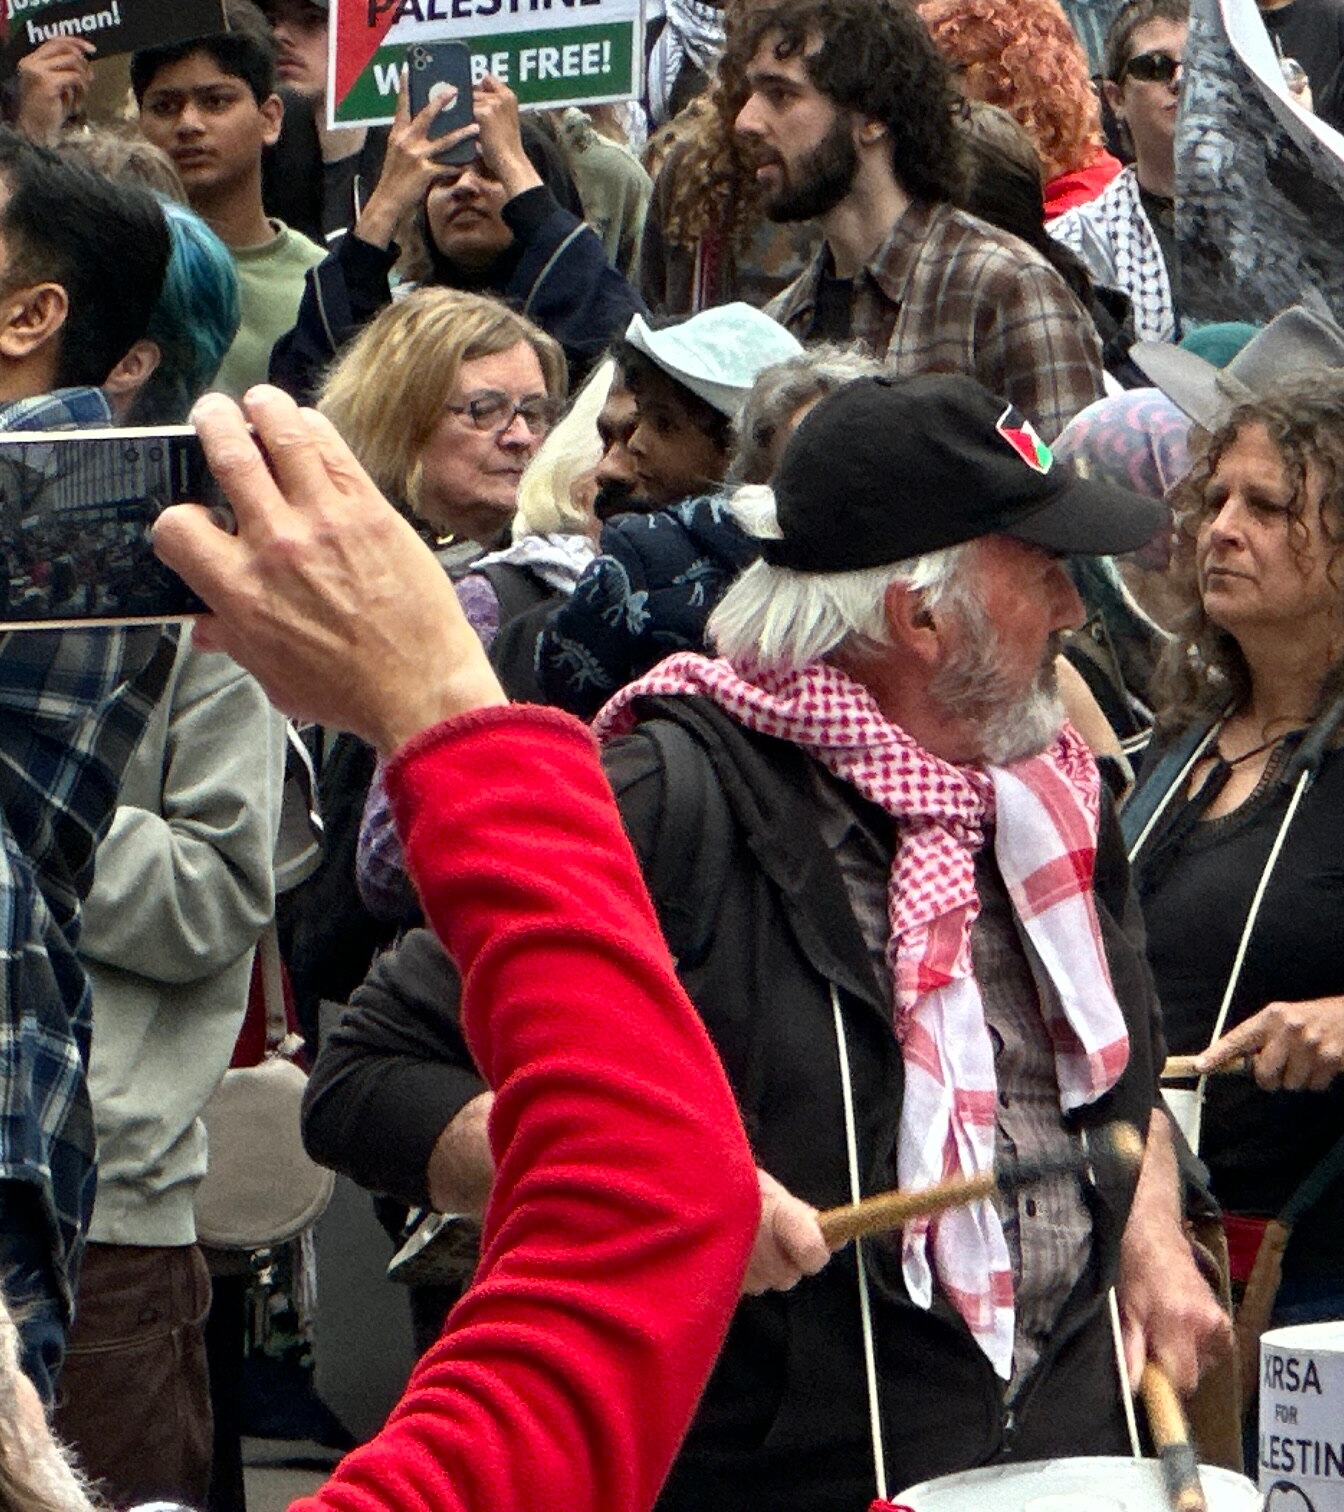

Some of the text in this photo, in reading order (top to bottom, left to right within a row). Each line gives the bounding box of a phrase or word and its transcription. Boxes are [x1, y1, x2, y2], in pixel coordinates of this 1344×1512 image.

[470, 39, 612, 87] BE FREE!
[1264, 1353, 1323, 1395] XRSA
[1274, 1403, 1299, 1426] FOR
